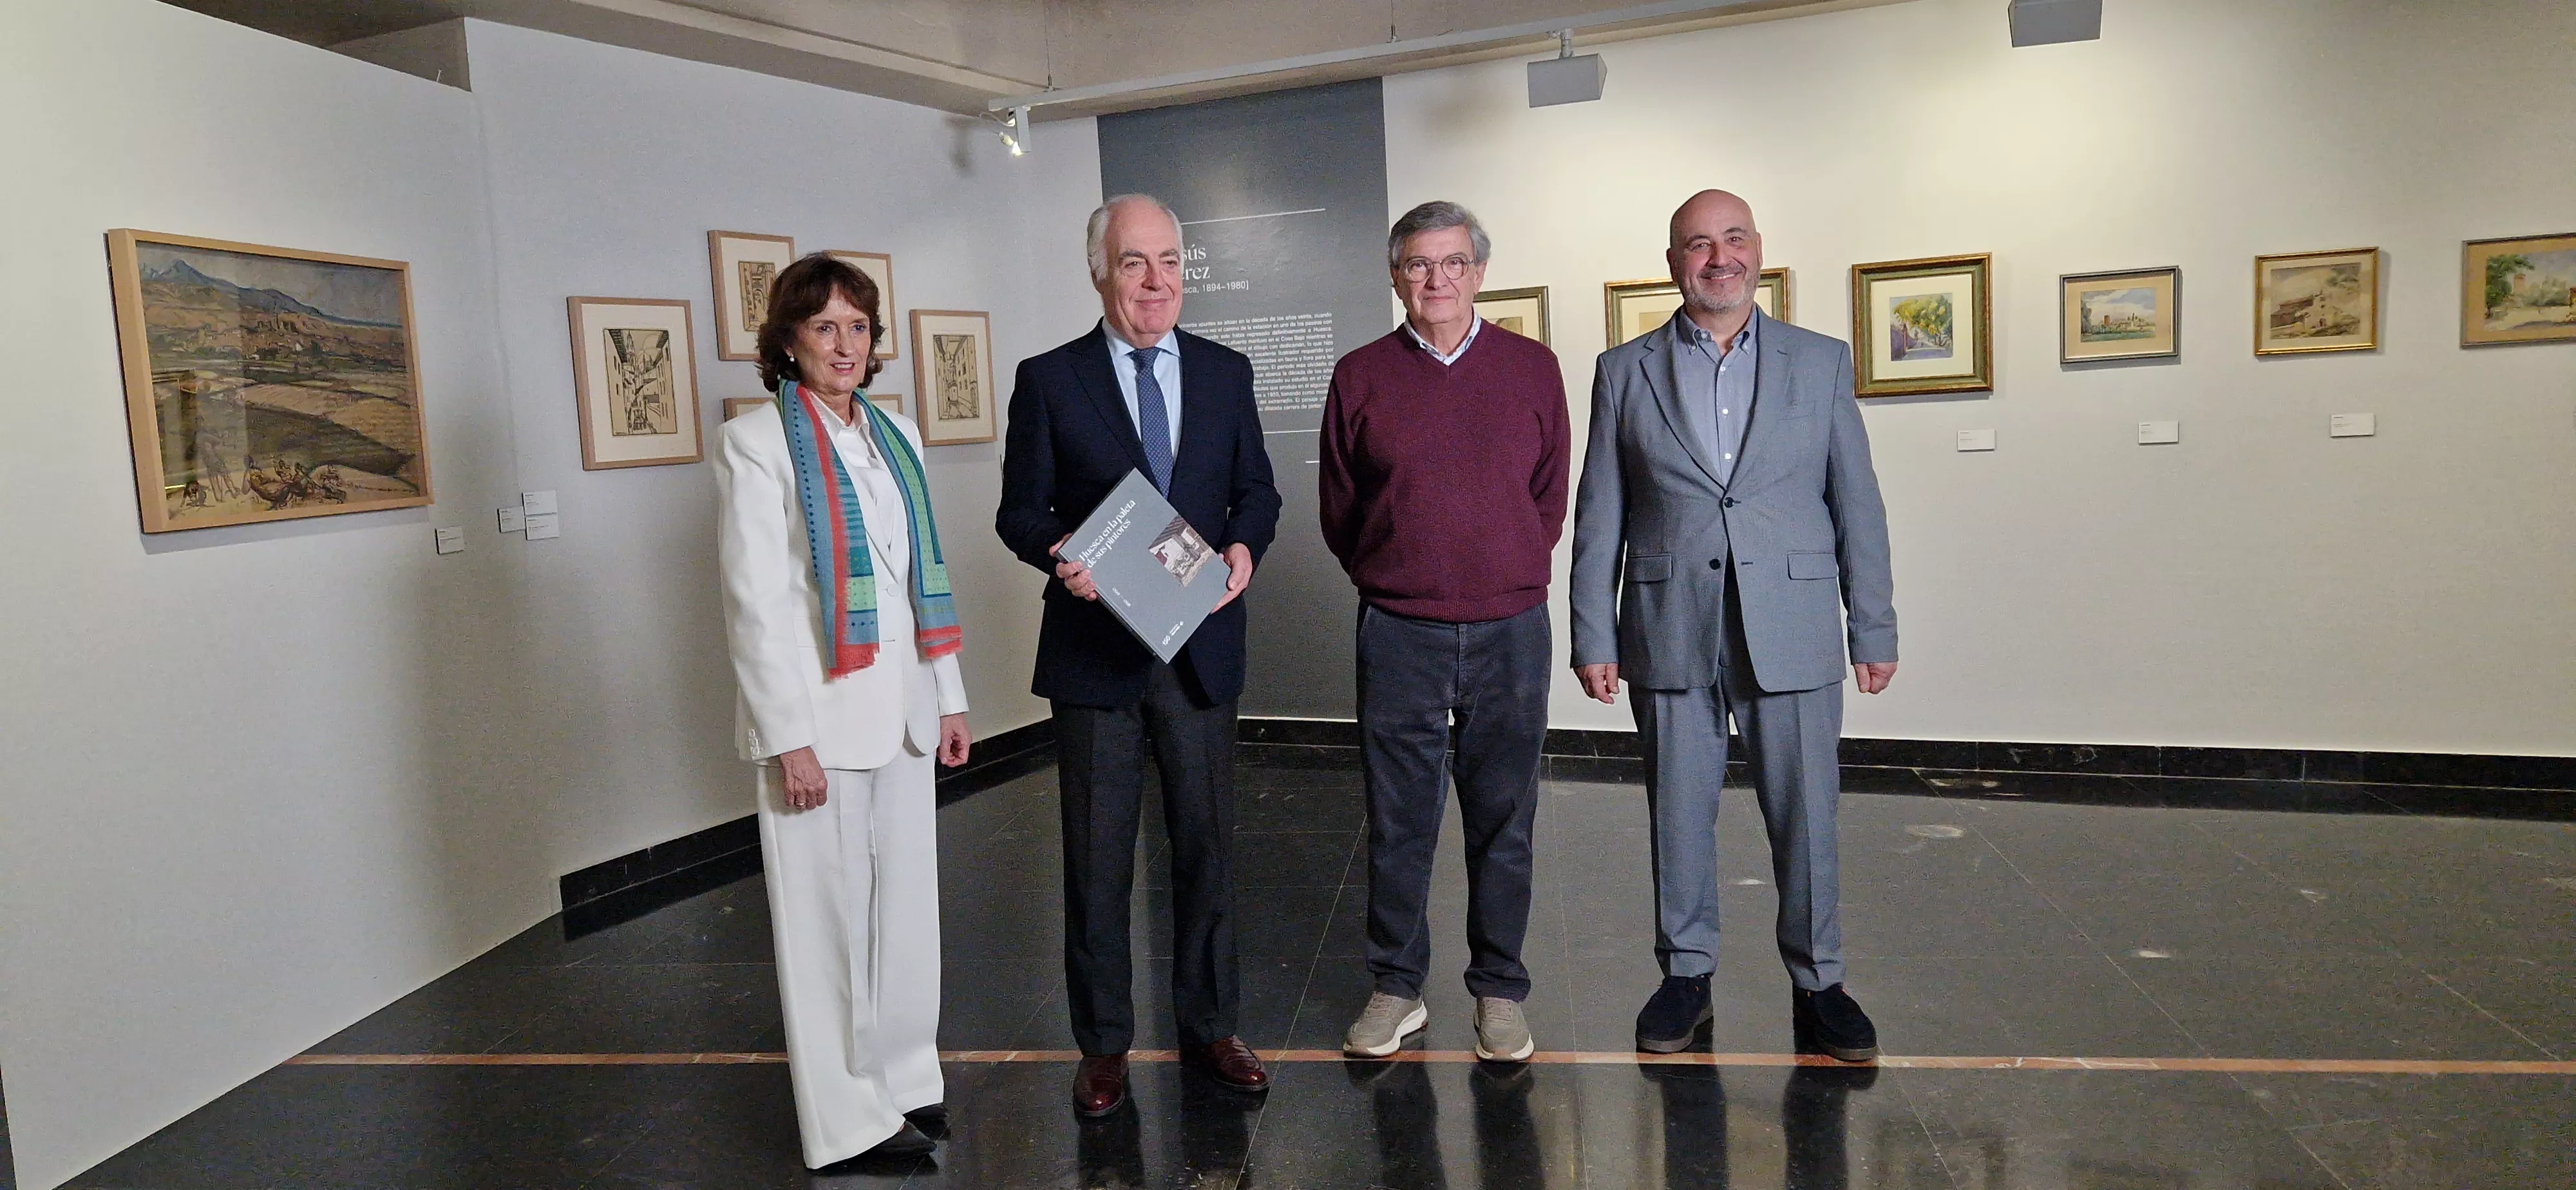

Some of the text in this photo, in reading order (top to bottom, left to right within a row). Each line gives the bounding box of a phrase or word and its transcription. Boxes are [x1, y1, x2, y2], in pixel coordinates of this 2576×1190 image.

[1183, 244, 1206, 260] sús
[1182, 267, 1210, 280] rez
[1079, 536, 1104, 561] Huesca
[1103, 527, 1112, 536] en
[1116, 500, 1135, 524] paleta
[1087, 520, 1130, 567] de sus pintores
